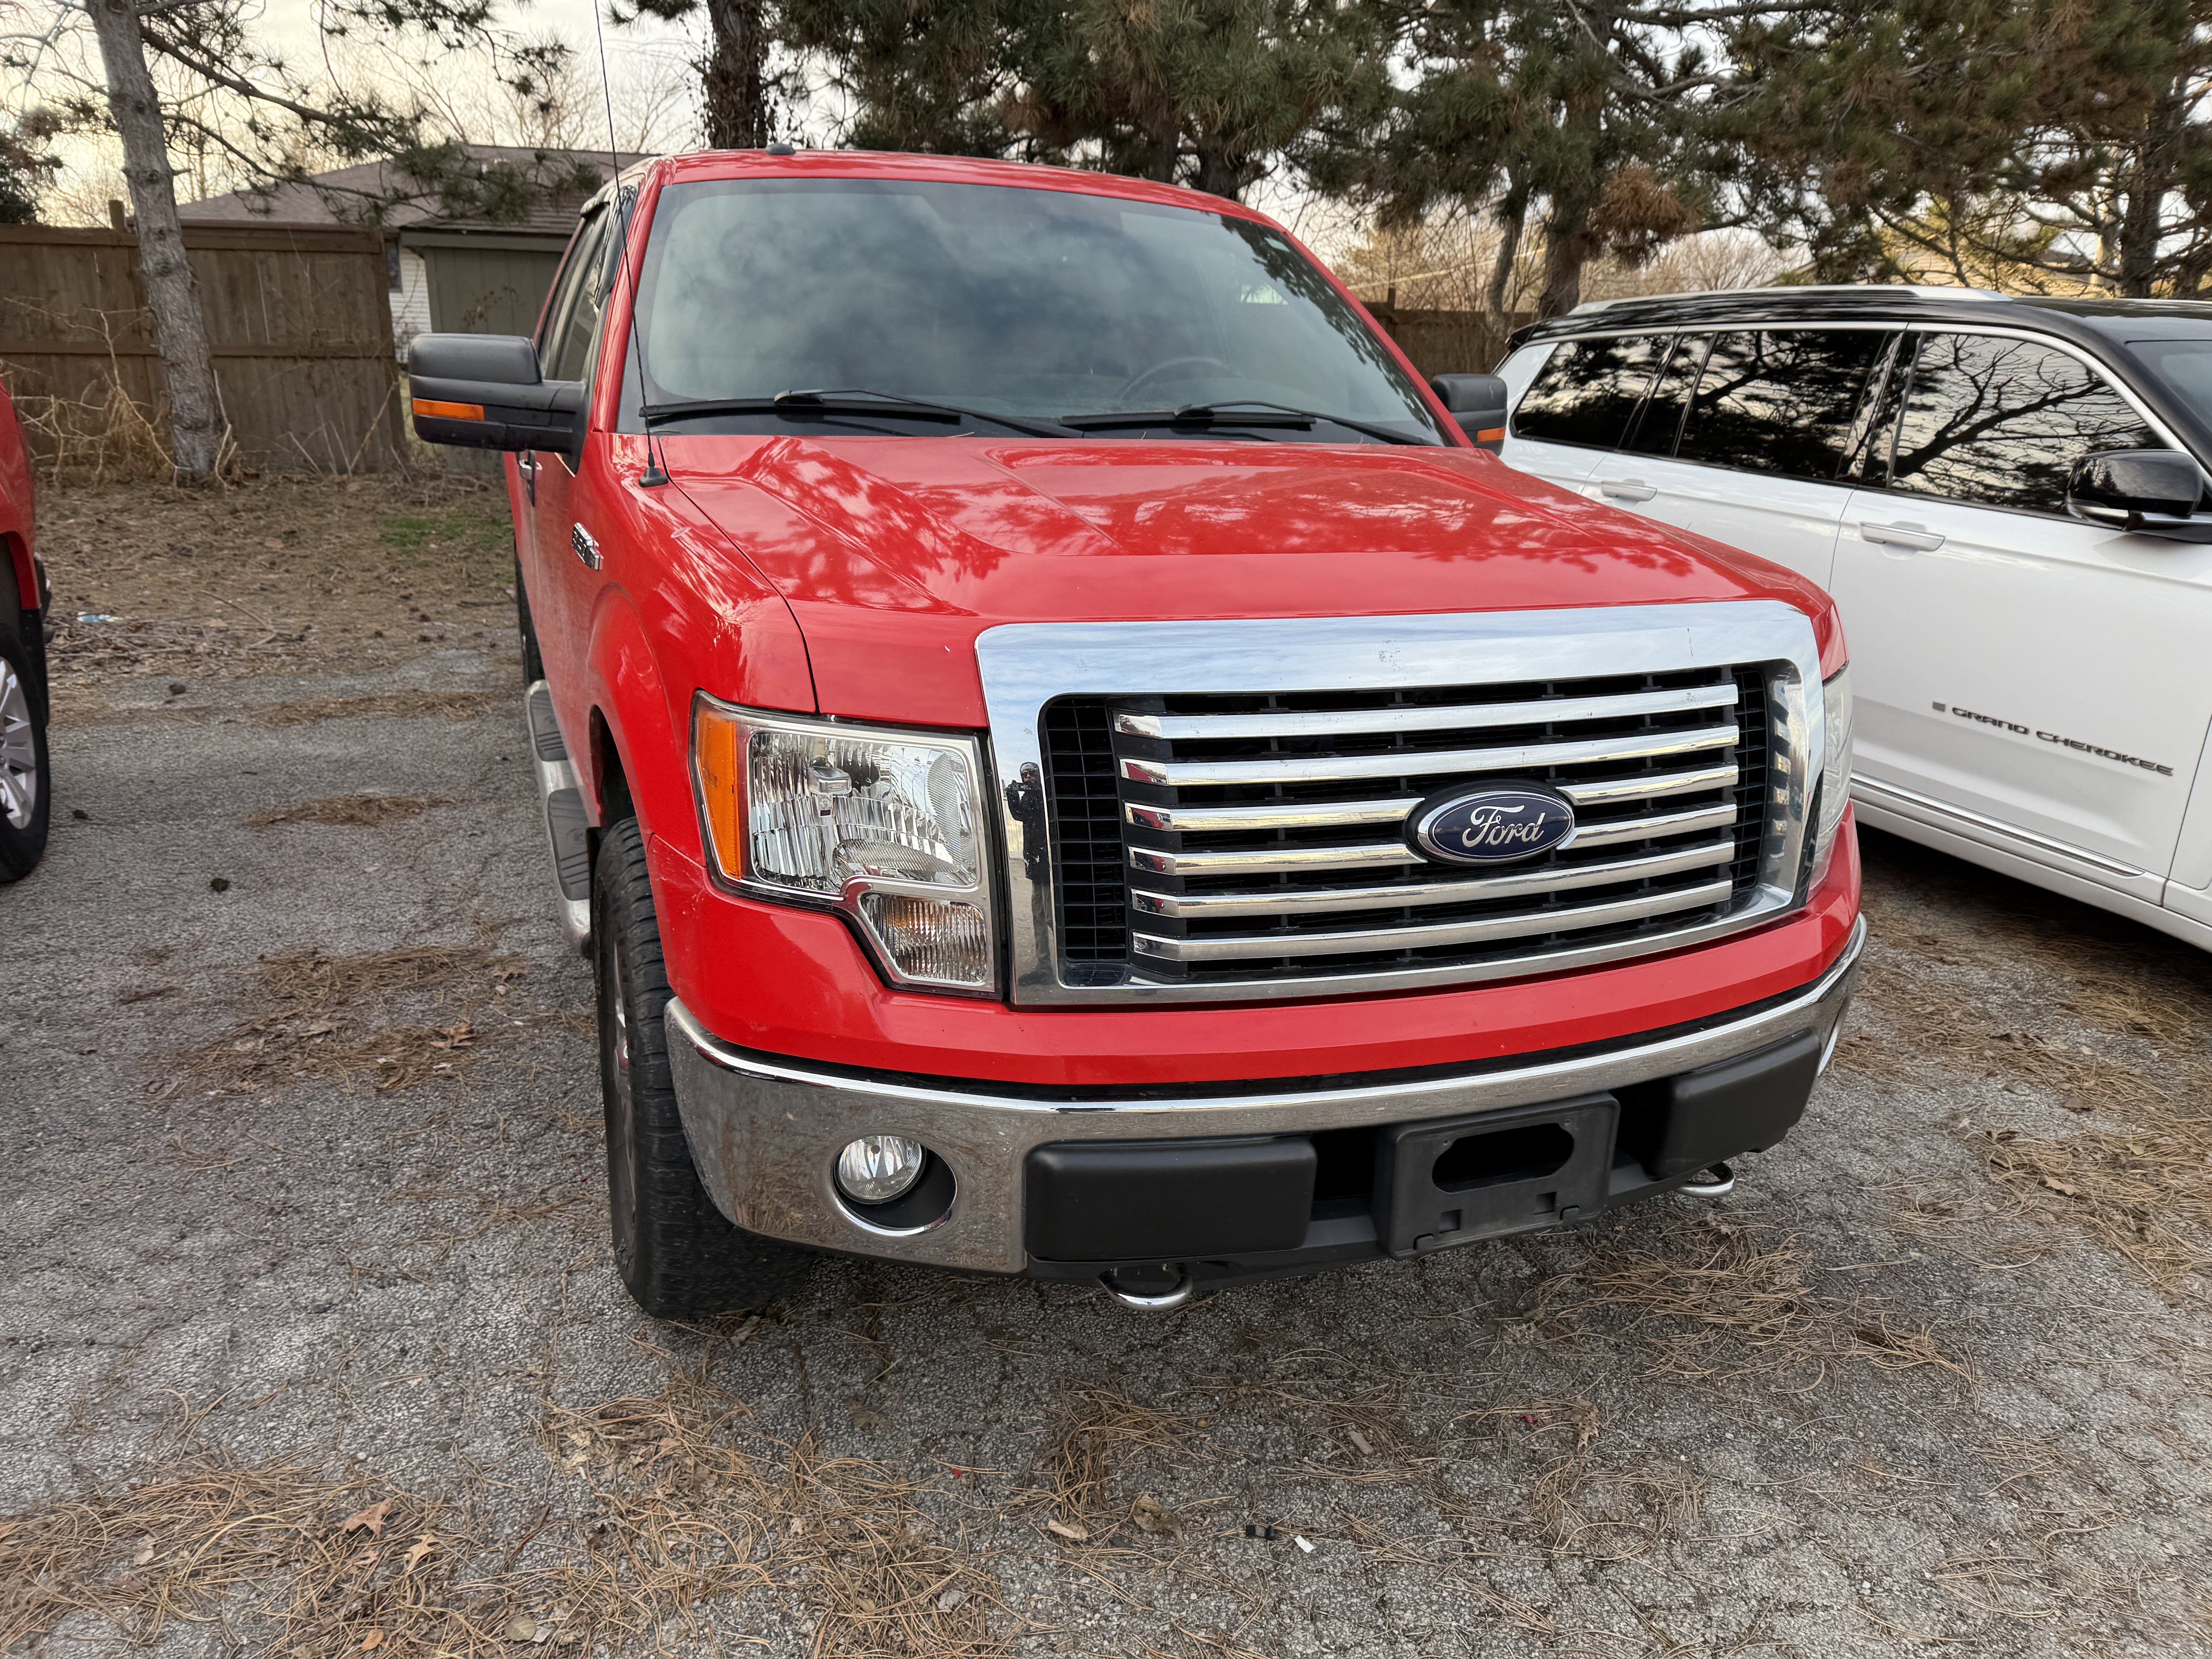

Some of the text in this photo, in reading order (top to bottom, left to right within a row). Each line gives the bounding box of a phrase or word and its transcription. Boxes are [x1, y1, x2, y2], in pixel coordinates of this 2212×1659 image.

[1952, 707, 2174, 776] GRAND CHEROKEE
[1462, 805, 1546, 847] Ford
